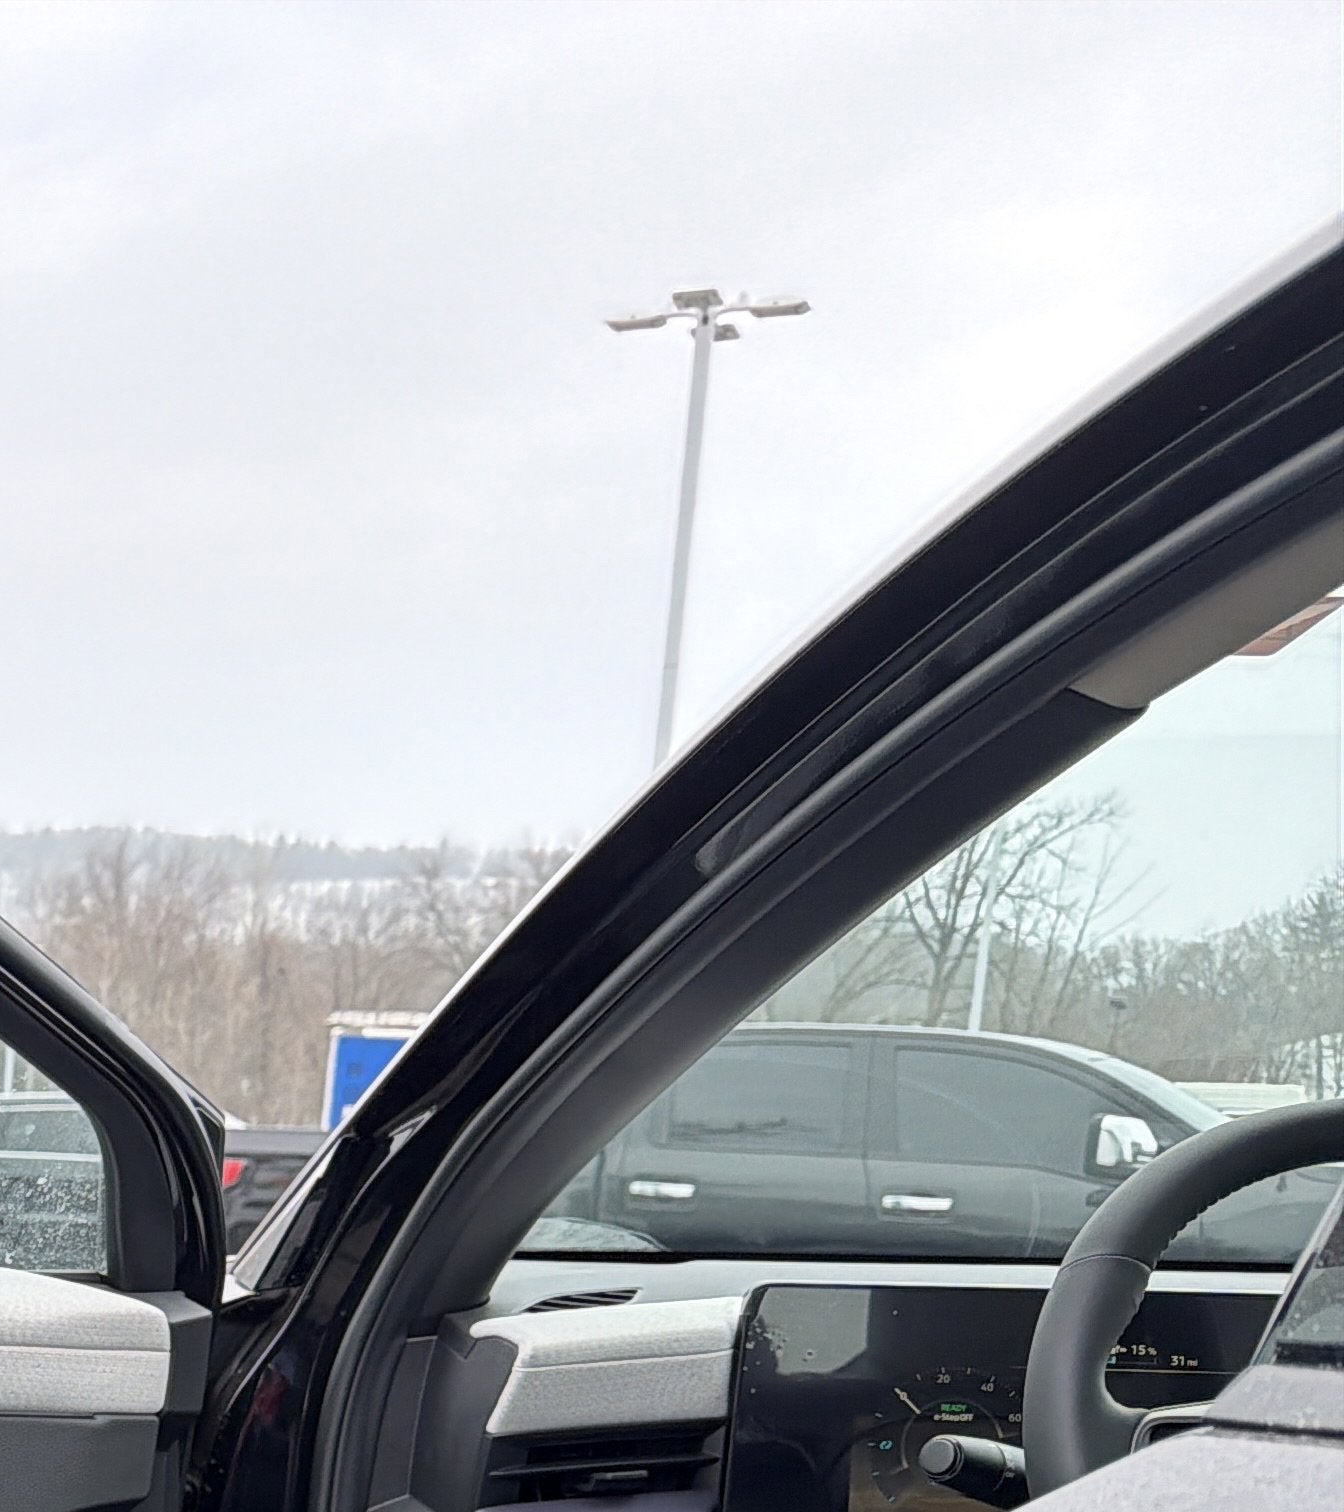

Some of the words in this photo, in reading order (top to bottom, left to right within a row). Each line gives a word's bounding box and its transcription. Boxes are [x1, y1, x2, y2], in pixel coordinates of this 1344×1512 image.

[936, 1374, 950, 1383] 20
[980, 1382, 993, 1392] 40
[941, 1404, 967, 1412] READY
[1008, 1413, 1022, 1422] 60
